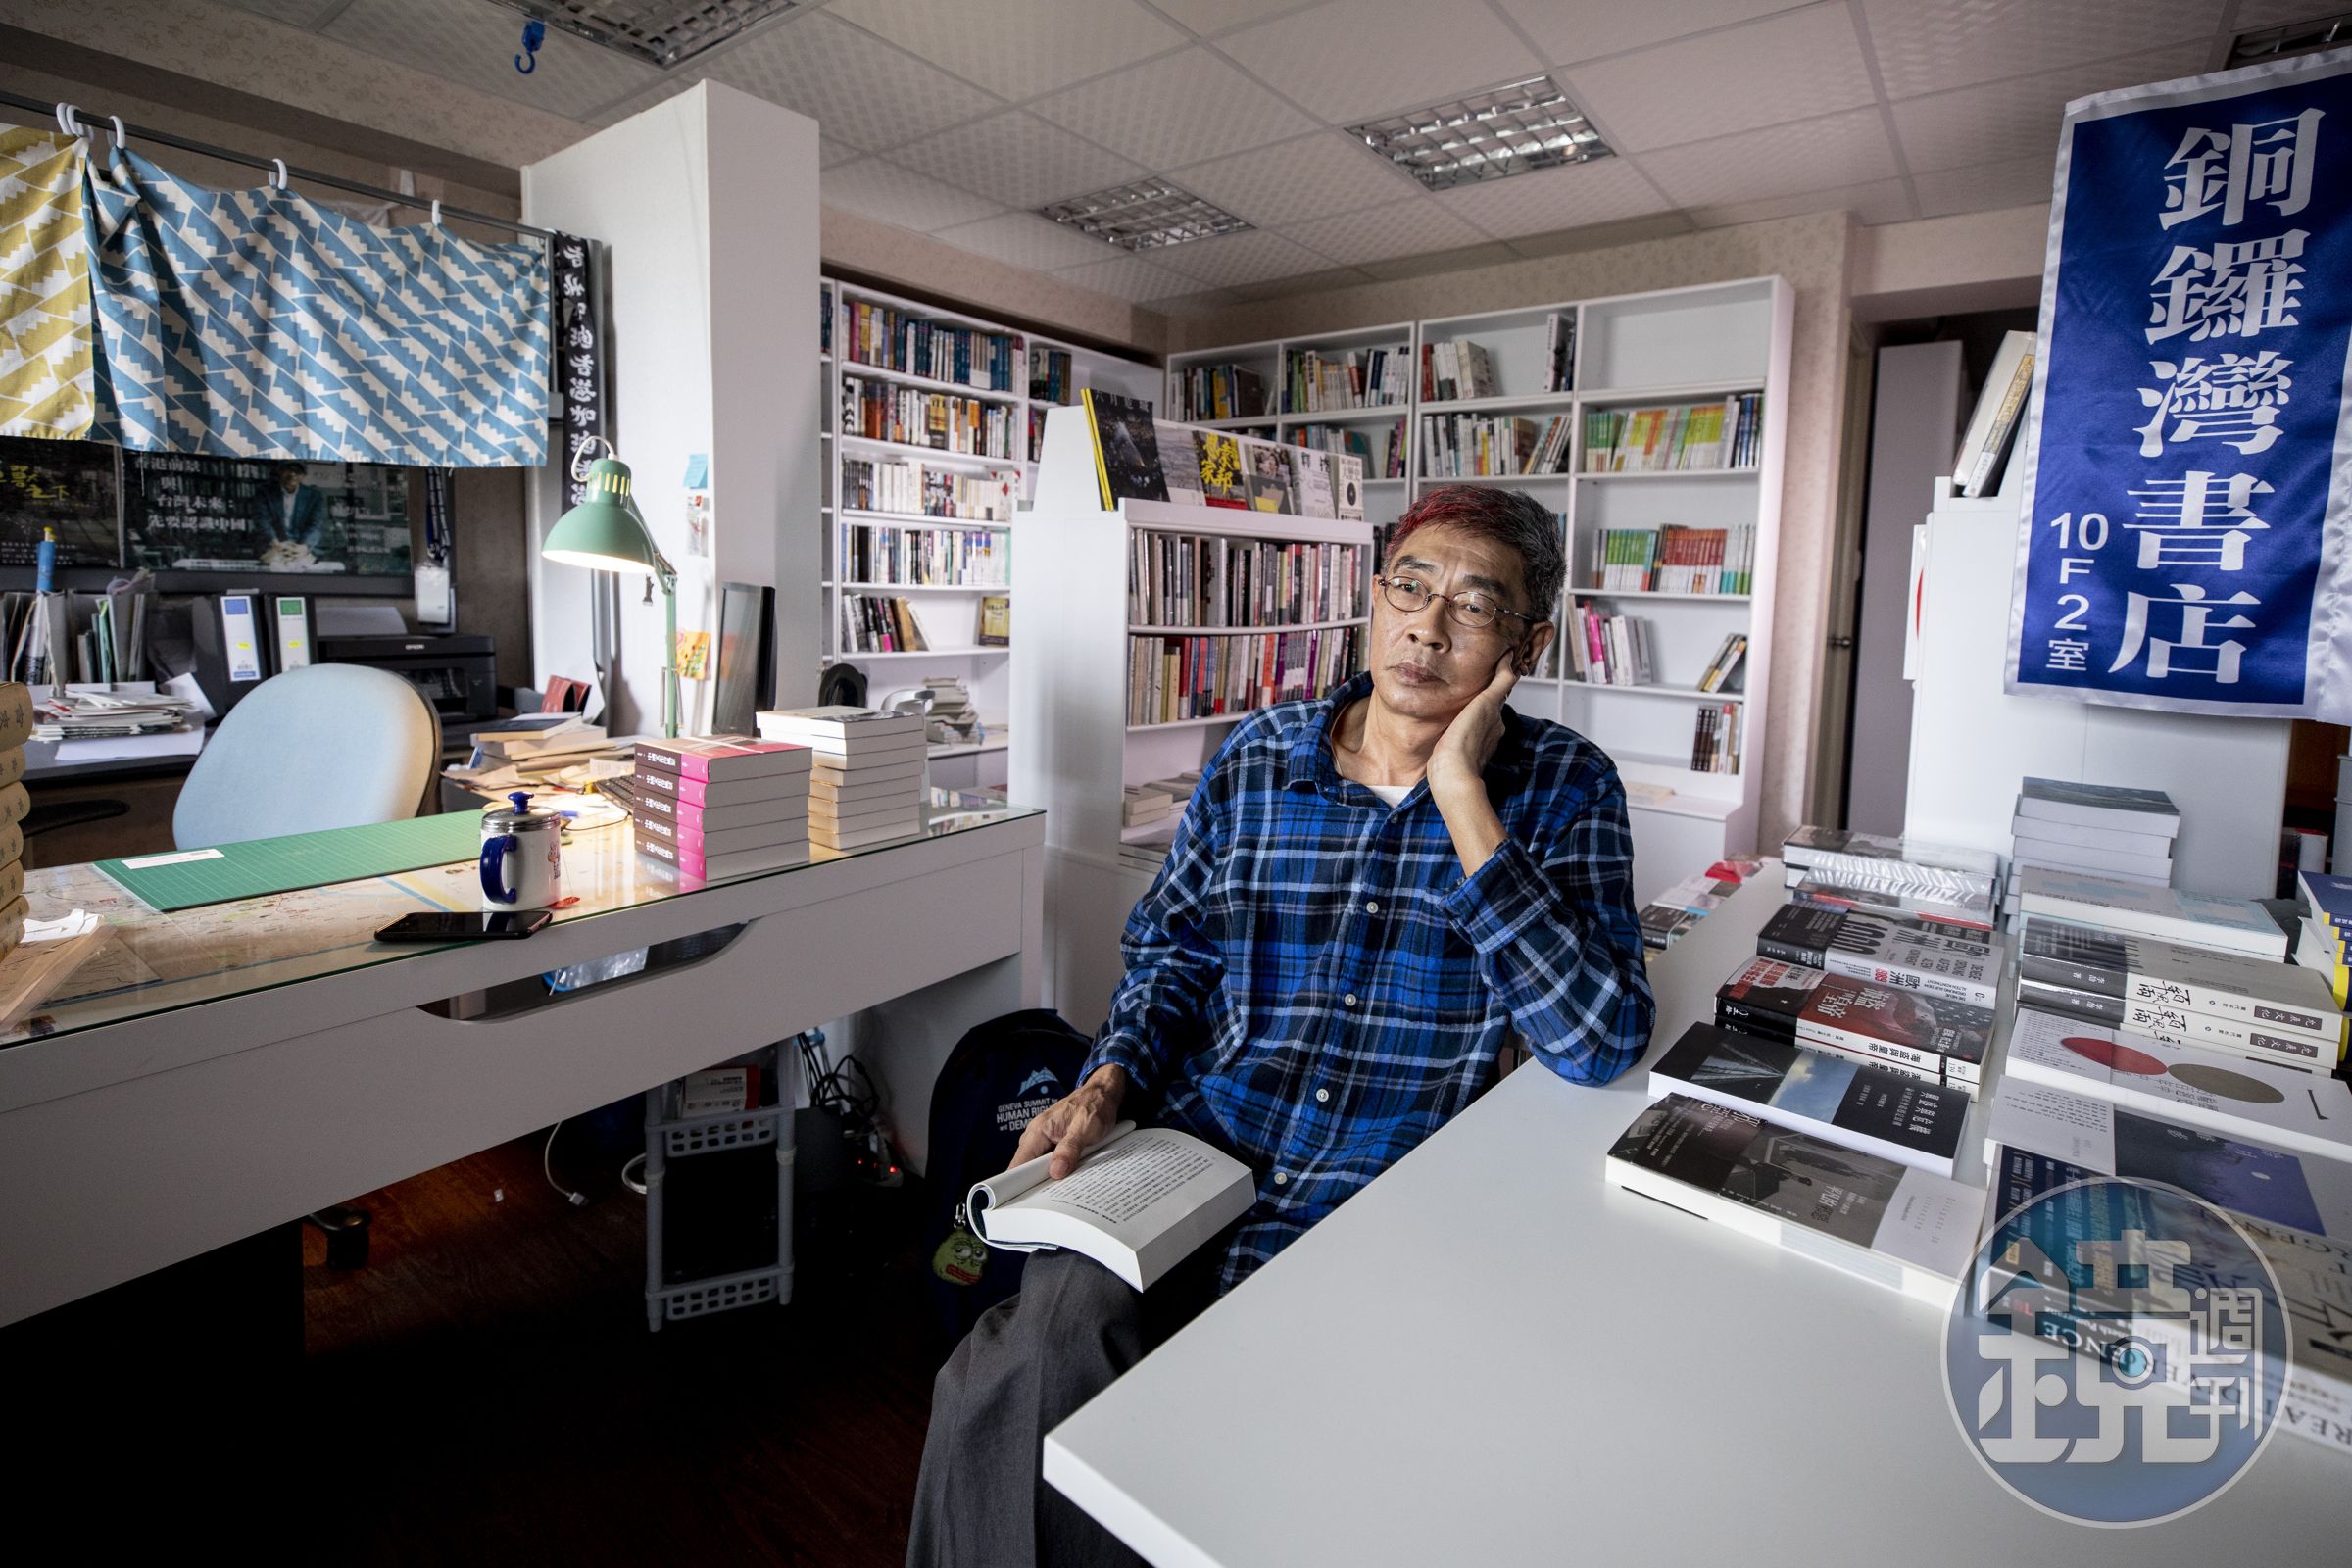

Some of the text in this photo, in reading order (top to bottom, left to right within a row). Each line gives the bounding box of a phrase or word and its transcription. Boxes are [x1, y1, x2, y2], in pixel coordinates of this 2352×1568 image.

[2108, 107, 2326, 684] 銅鑼灣書店
[1889, 970, 1921, 991] 歐洲
[1851, 986, 1892, 1011] 海盜
[2261, 1008, 2318, 1028] 允晨文化
[1869, 1042, 1921, 1063] 海盜與皇帝
[2256, 1035, 2314, 1055] 允晨文化
[998, 1102, 1022, 1112] GENEVA
[1023, 1098, 1051, 1109] SUMMIT
[996, 1110, 1029, 1125] HUMAN
